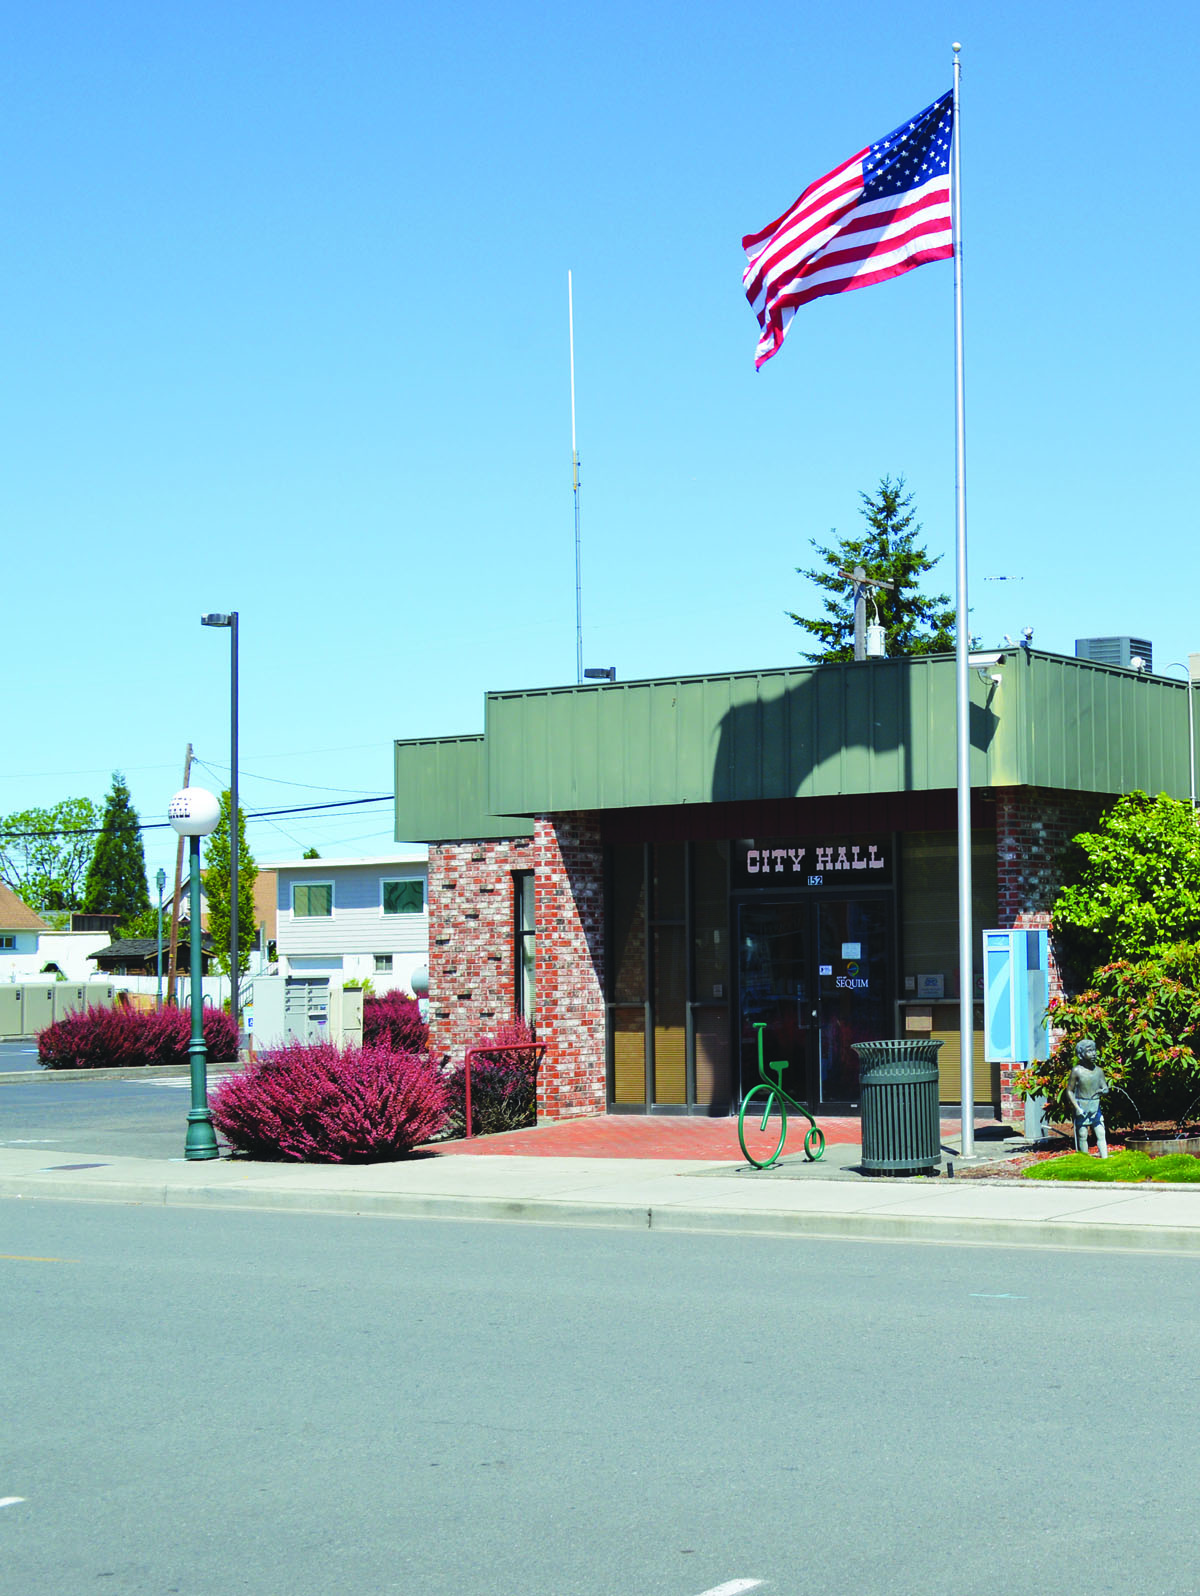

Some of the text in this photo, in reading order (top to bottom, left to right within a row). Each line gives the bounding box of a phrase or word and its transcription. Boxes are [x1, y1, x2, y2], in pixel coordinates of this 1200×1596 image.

[747, 845, 884, 873] CITY HALL
[808, 875, 823, 886] 152
[835, 978, 869, 989] SEQUIM
